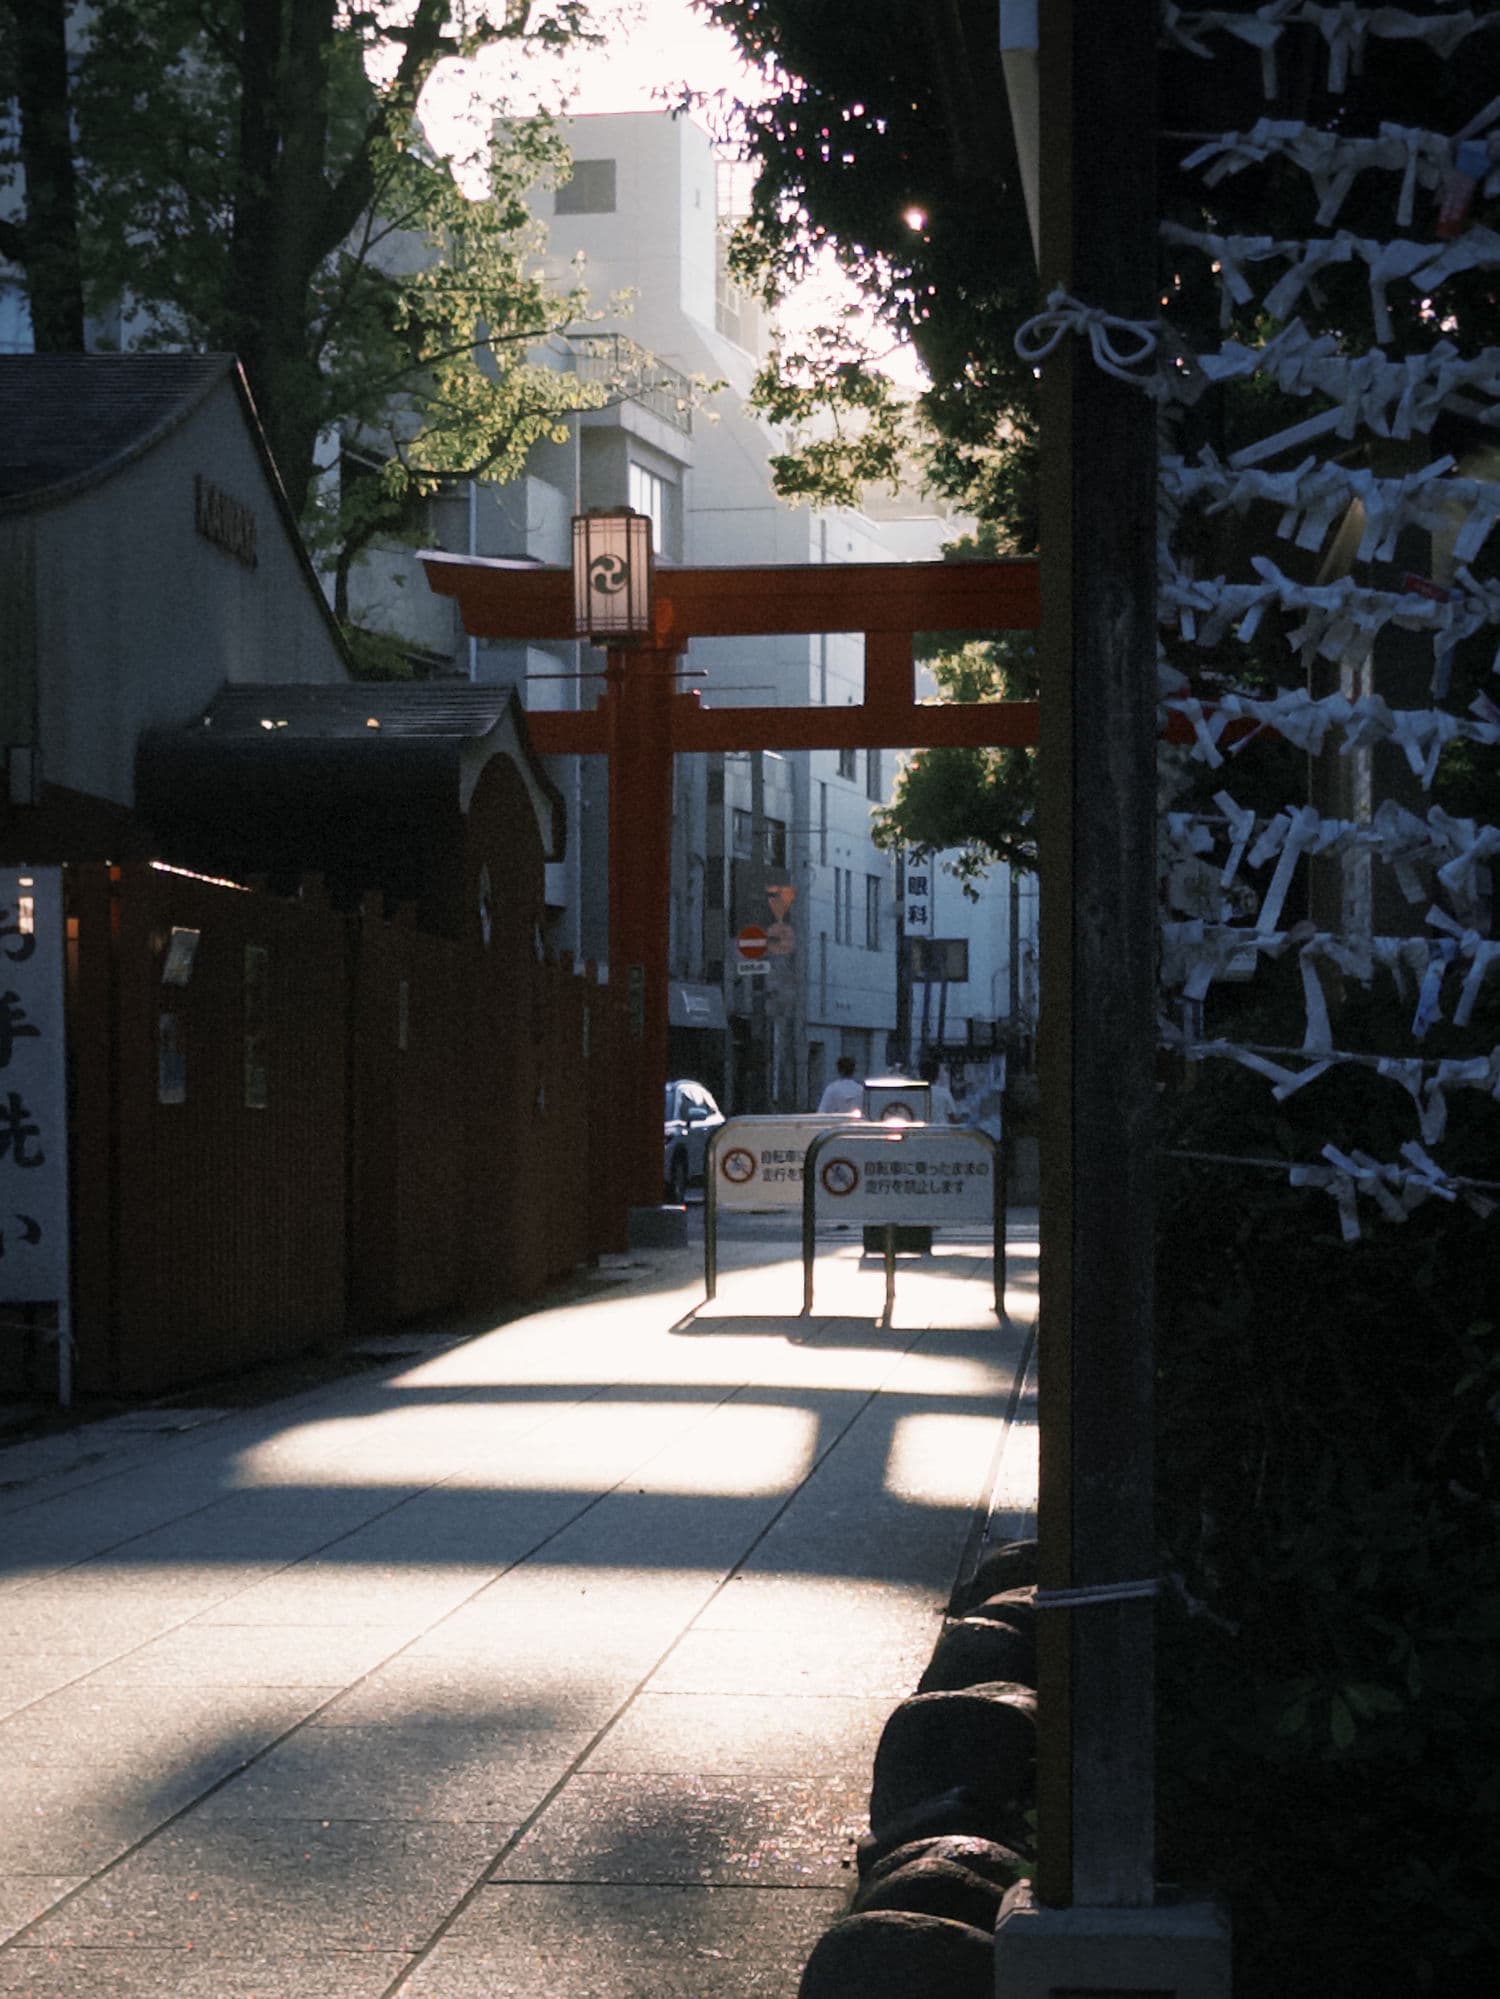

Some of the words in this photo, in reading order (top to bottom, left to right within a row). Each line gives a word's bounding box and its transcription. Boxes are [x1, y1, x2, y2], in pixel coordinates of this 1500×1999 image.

[864, 1161, 989, 1177] 自転車に乗ったままの
